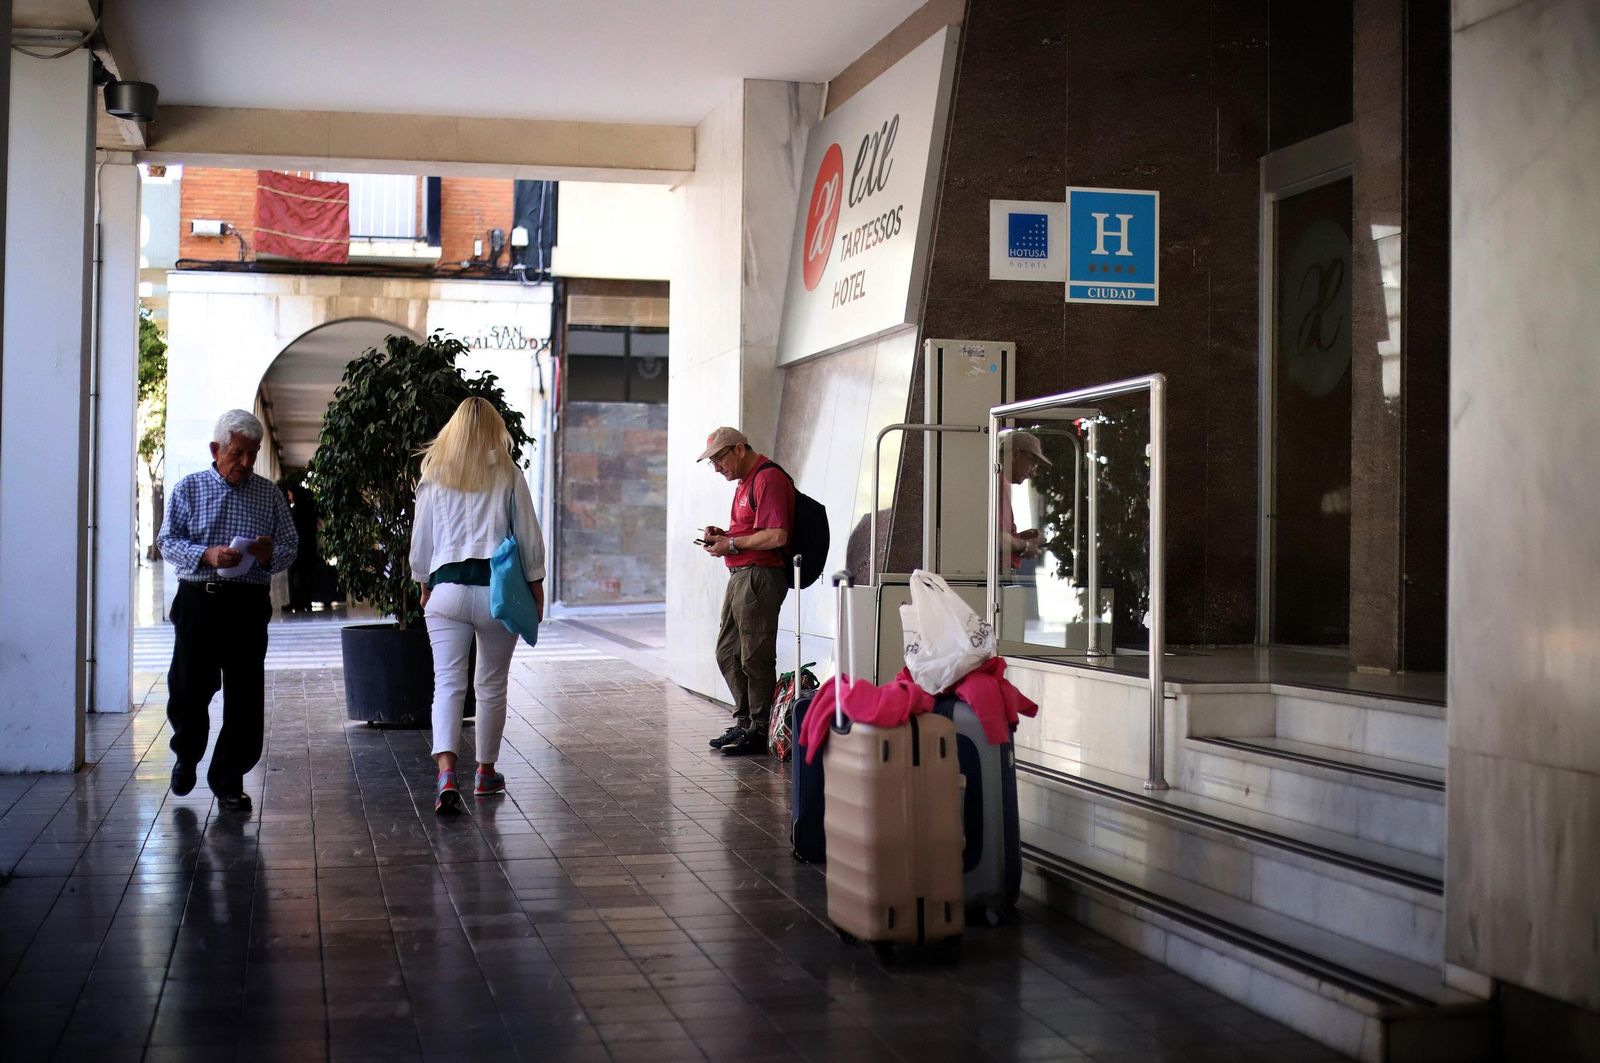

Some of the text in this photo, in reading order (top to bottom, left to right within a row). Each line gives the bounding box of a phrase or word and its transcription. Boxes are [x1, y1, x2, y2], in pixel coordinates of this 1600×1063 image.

[848, 113, 900, 209] exe
[840, 204, 904, 263] TARTESSOS
[1091, 212, 1134, 256] H
[1009, 248, 1047, 258] HOTUSA
[1009, 260, 1048, 269] hotels
[831, 269, 866, 310] HOTEL
[1087, 287, 1136, 299] CIUDAD
[490, 325, 522, 338] SAN
[462, 336, 549, 350] SALVADOR
